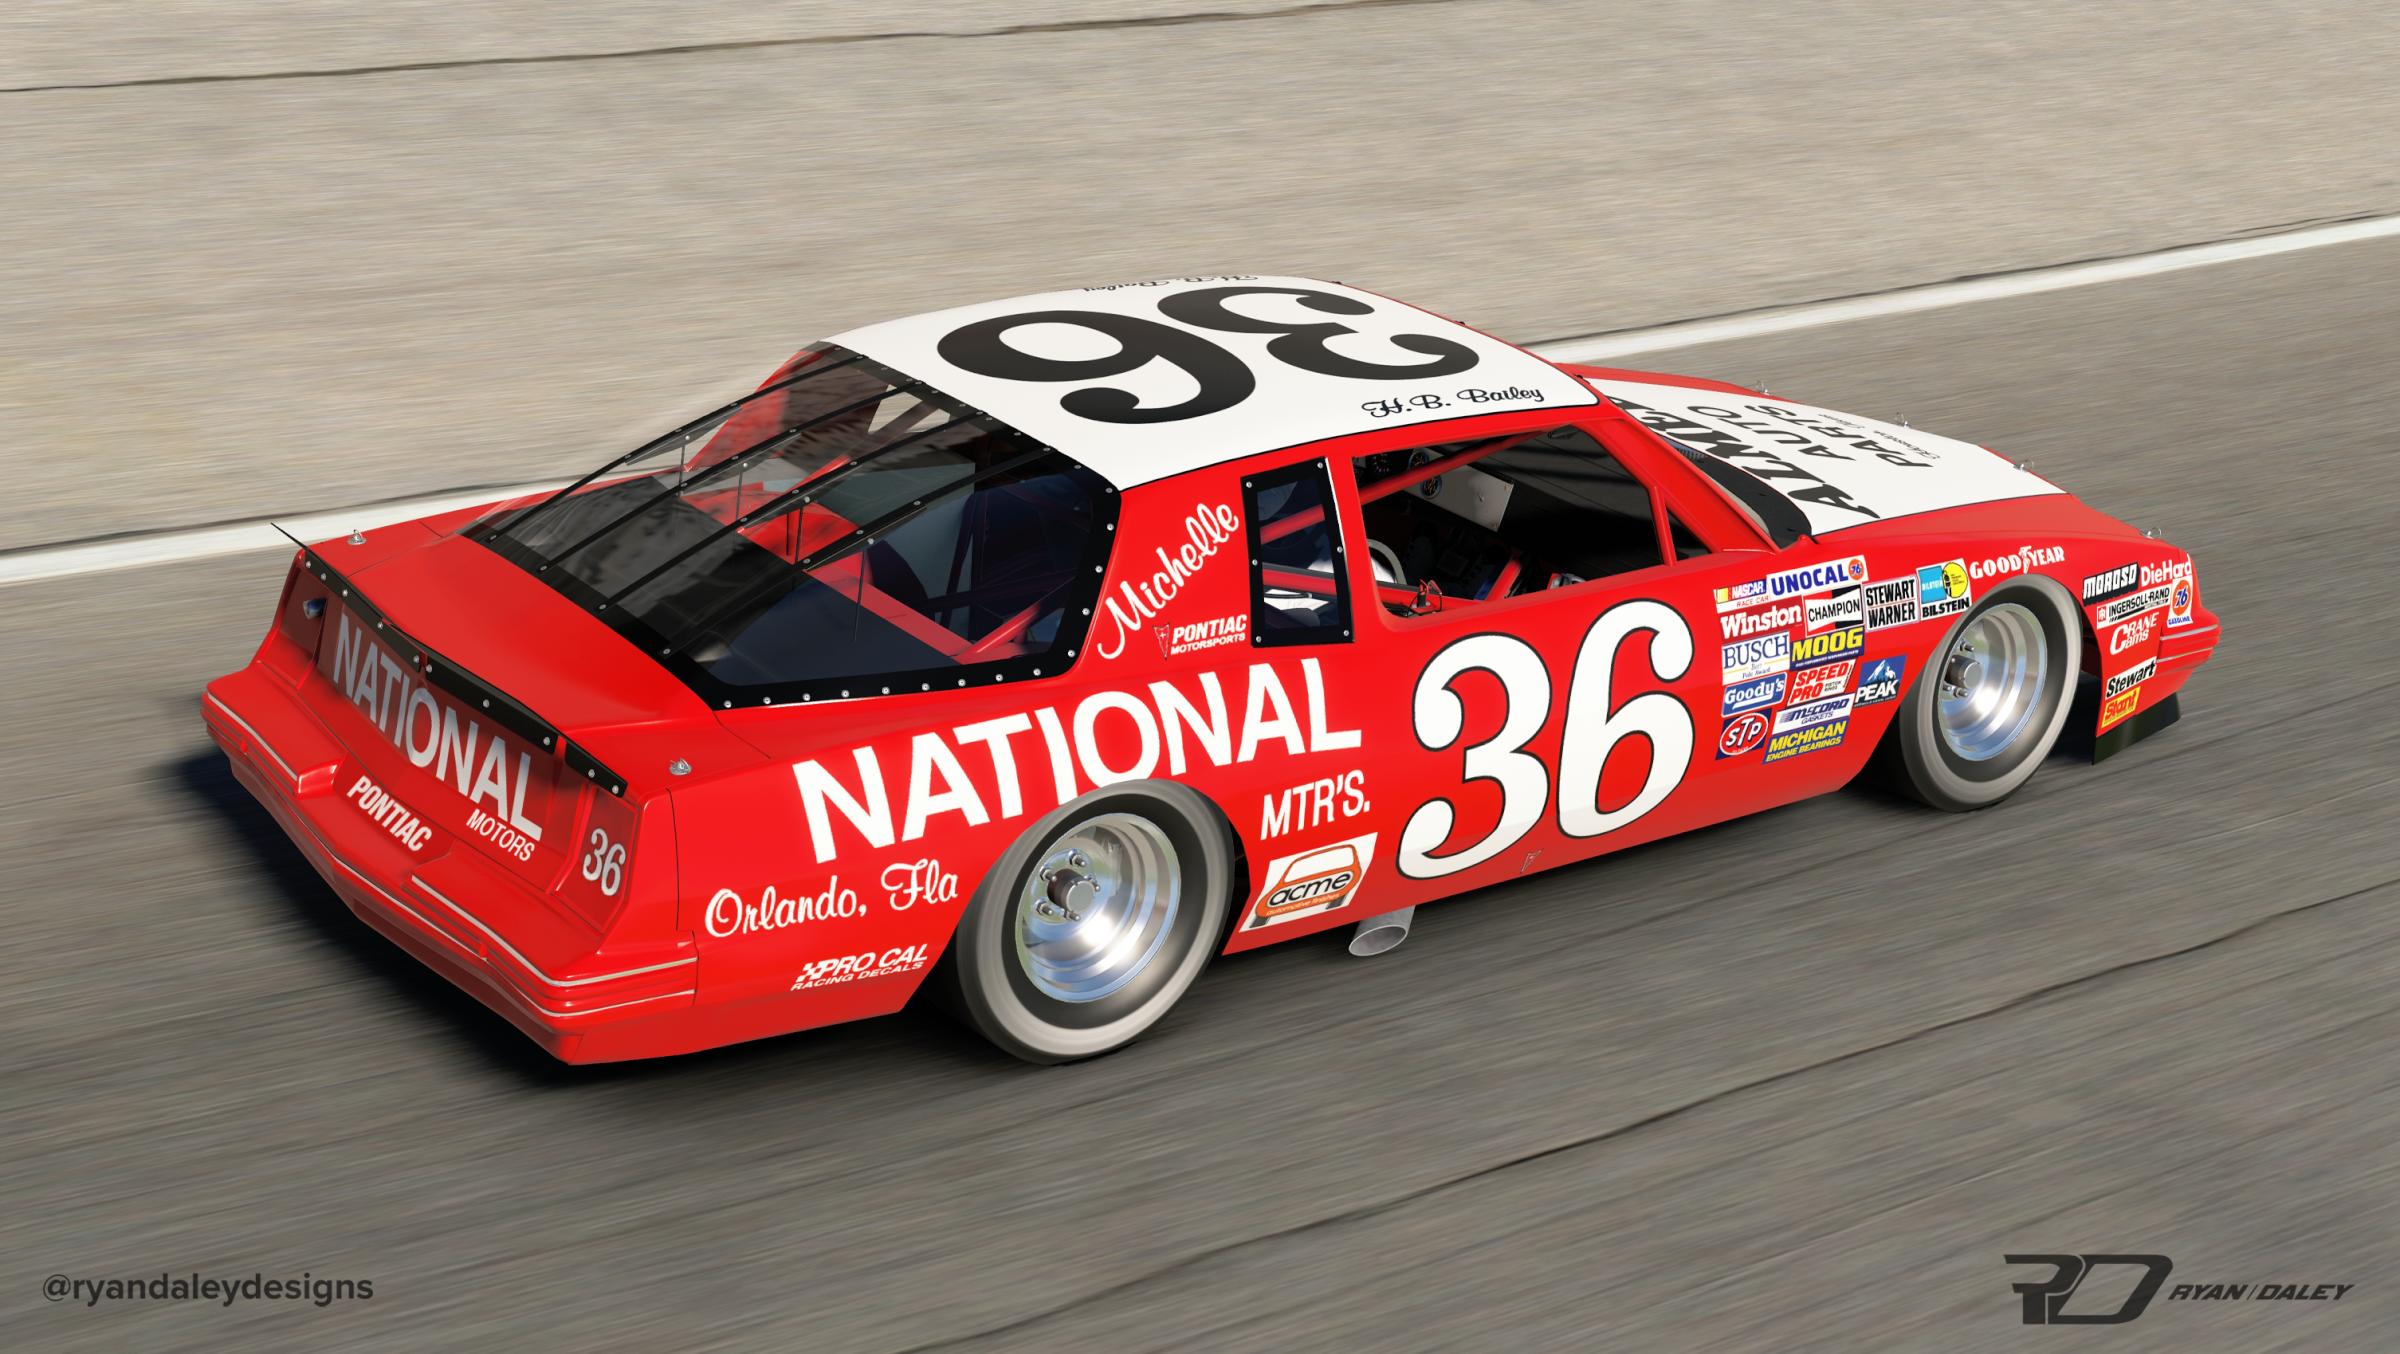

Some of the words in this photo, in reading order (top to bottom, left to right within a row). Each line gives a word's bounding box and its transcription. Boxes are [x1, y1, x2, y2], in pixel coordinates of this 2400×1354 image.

[937, 286, 1480, 424] 36
[1456, 387, 1544, 402] Bailey
[1686, 405, 1856, 461] AUTO
[1744, 405, 1934, 468] PARTS
[1850, 564, 1862, 576] 76
[1969, 546, 2065, 579] GOODYEAR
[2140, 553, 2192, 587] DieHard
[1097, 500, 1240, 660] Michelle
[1771, 563, 1849, 596] UNOCAL
[1865, 579, 1915, 606] STEWART
[2083, 563, 2138, 599] MOROSO
[1737, 598, 1754, 607] RACE
[1756, 595, 1769, 604] CAR
[1808, 597, 1860, 622] CHAMPION
[1921, 597, 1970, 618] BILSTEIN
[2108, 587, 2170, 617] INGERSOLL-RAND
[2176, 588, 2188, 606] 76
[1172, 614, 1247, 645] PONTIAC
[1720, 605, 1802, 639] Winston
[1868, 602, 1916, 629] WARNER
[2168, 616, 2191, 625] GASOLINE
[1170, 632, 1245, 655] MOTORSPORTS
[1723, 634, 1789, 669] BUSCH
[1791, 627, 1864, 662] MOOG
[1795, 662, 1850, 687] SPEED
[2105, 660, 2156, 698] Stewart
[1724, 678, 1785, 709] Goody's
[1789, 682, 1824, 704] PRO
[1854, 679, 1899, 703] PEAK
[333, 614, 544, 842] NATIONAL
[1725, 717, 1763, 746] STP
[1801, 712, 1833, 725] GASKETS
[1396, 599, 1695, 880] 36
[1766, 747, 1797, 763] ENGINE
[1798, 736, 1841, 754] BEARINGS
[1768, 721, 1847, 753] MICHIGAN
[792, 658, 1362, 864] NATIONAL
[346, 775, 432, 852] PONTIAC
[1260, 770, 1370, 840] MTR'S.
[466, 808, 536, 862] MOTORS
[582, 828, 626, 896] 36
[704, 875, 867, 938] Orlando,
[880, 858, 958, 911] Fla
[1269, 873, 1351, 906] acme
[878, 943, 928, 968] CAL
[790, 973, 855, 991] RACING
[857, 961, 924, 980] DECALS
